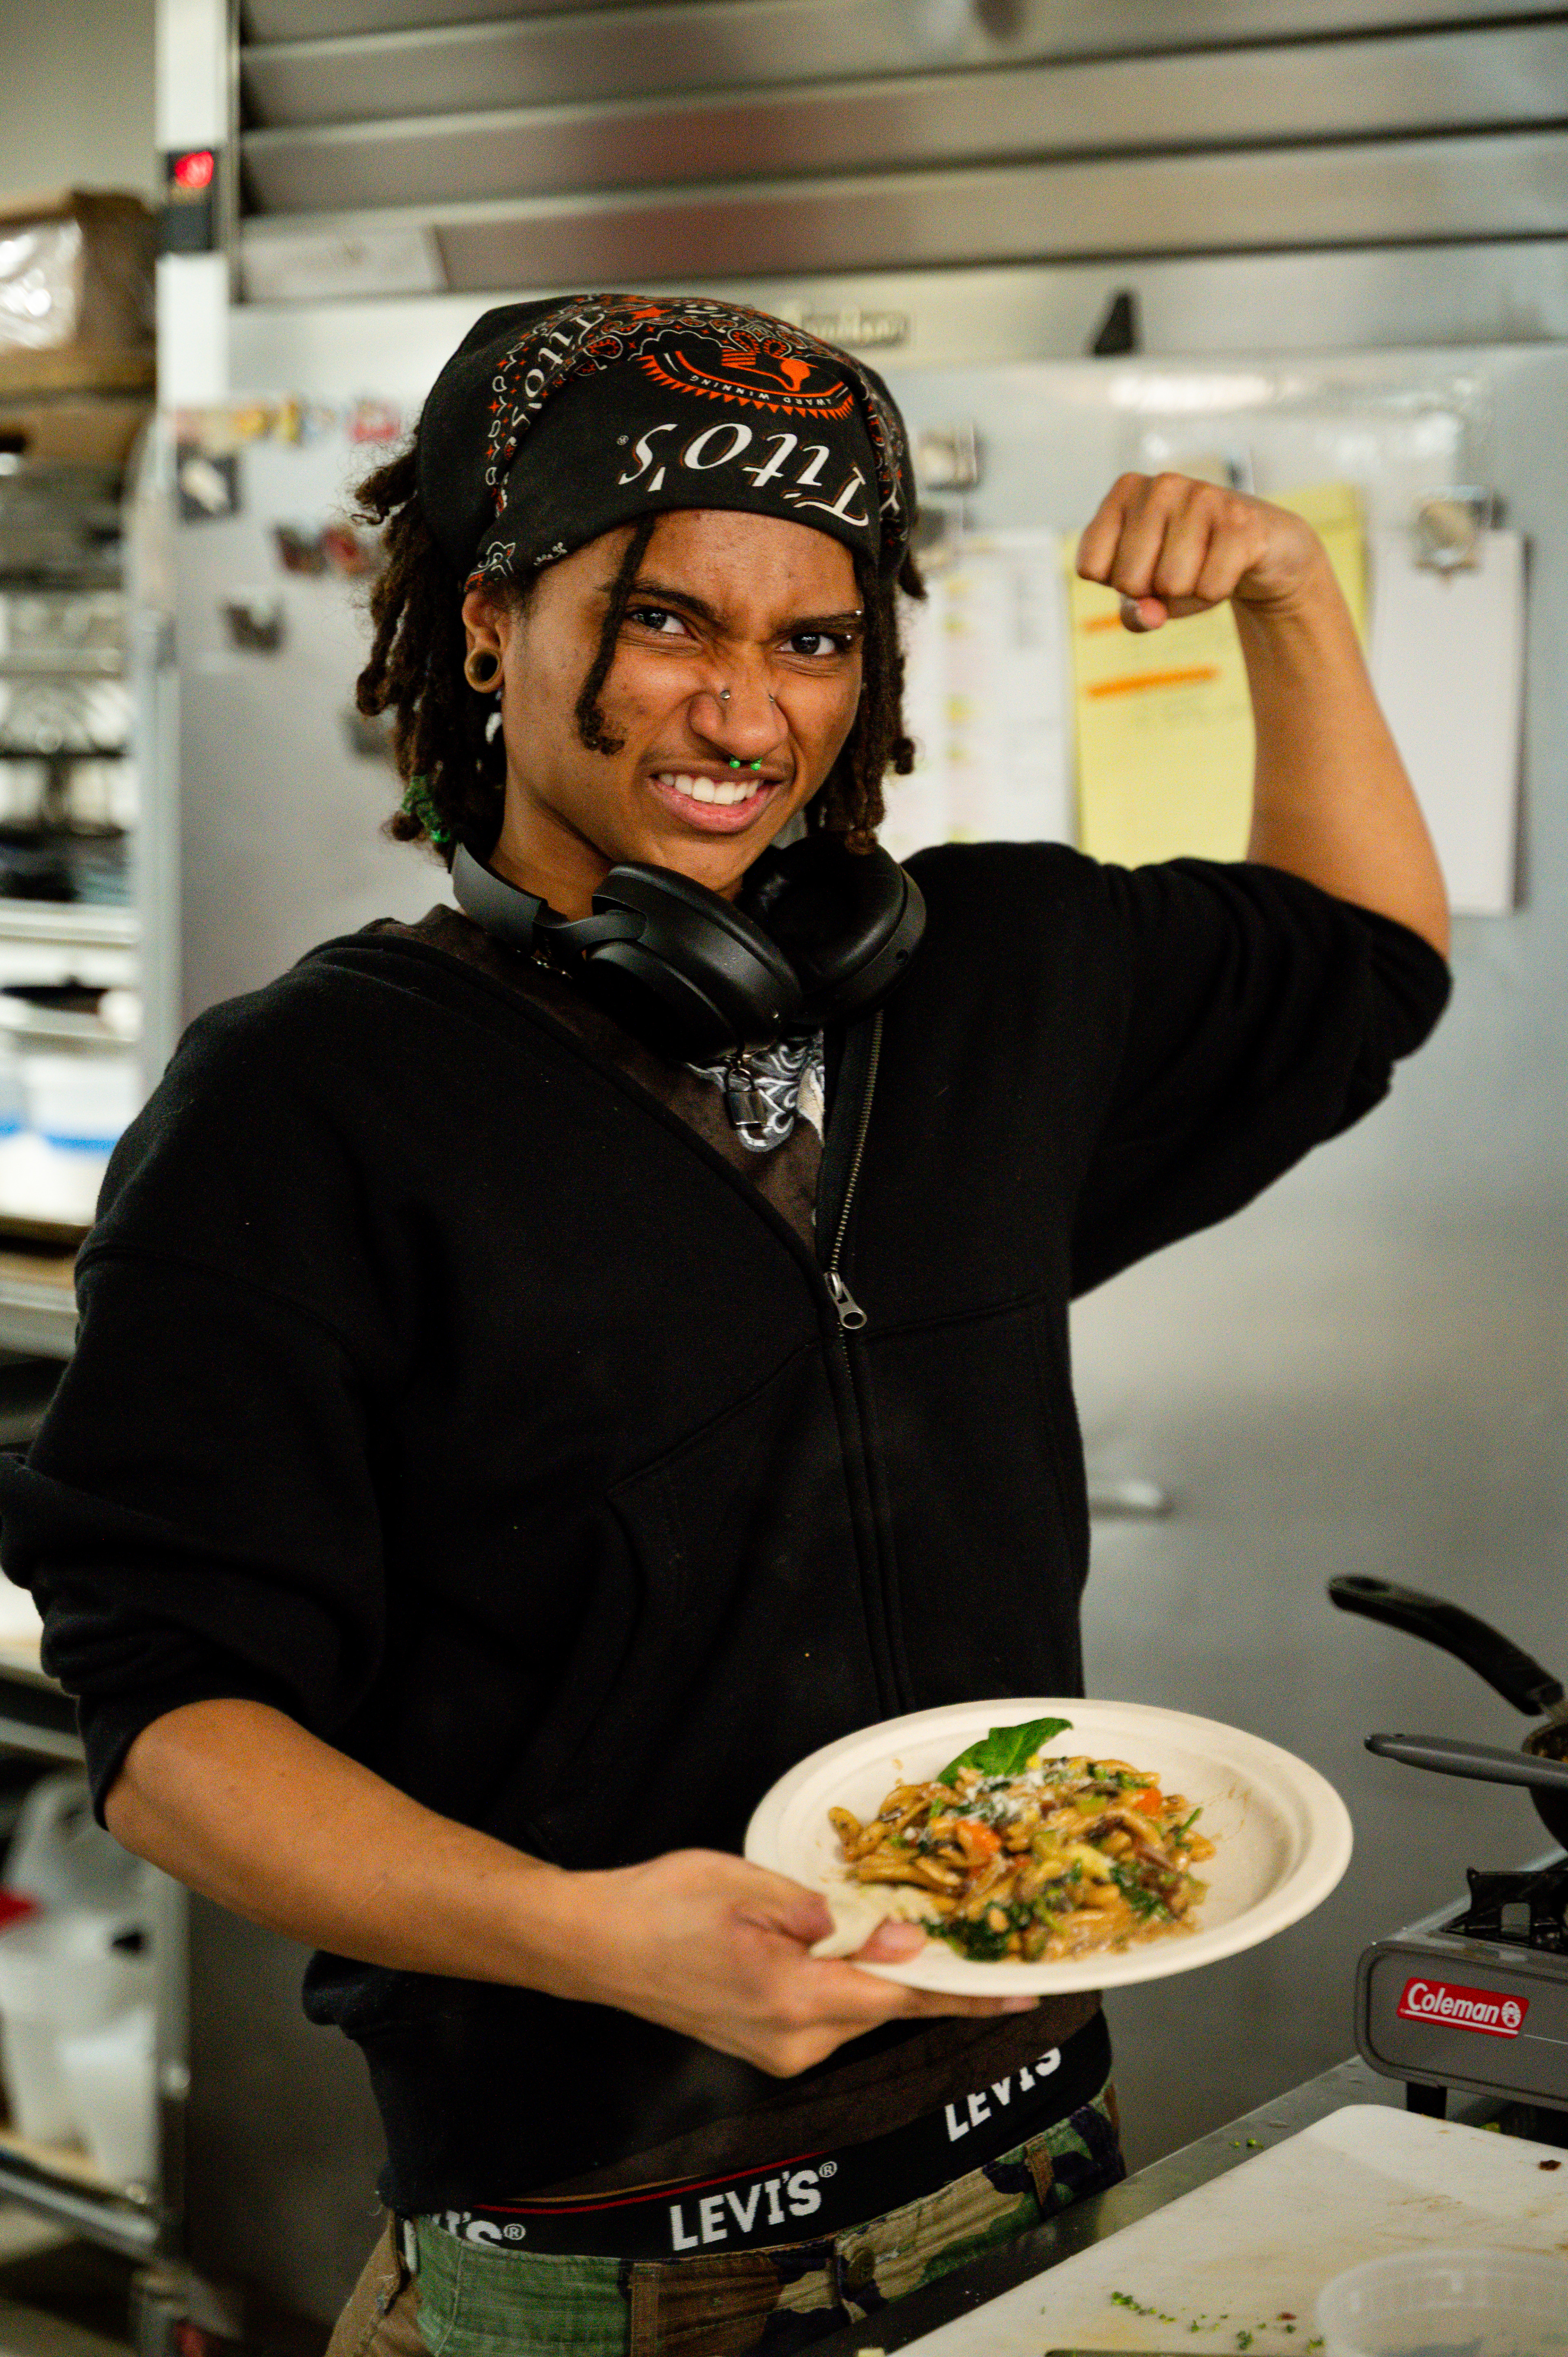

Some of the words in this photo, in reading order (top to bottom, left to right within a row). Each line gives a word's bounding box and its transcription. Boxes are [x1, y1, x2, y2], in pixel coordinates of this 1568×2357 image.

[690, 375, 770, 400] WINNING
[783, 397, 831, 406] AWARD
[618, 423, 869, 526] Tito's
[1408, 1982, 1500, 2023] Coleman
[944, 2047, 1061, 2142] LEVIS
